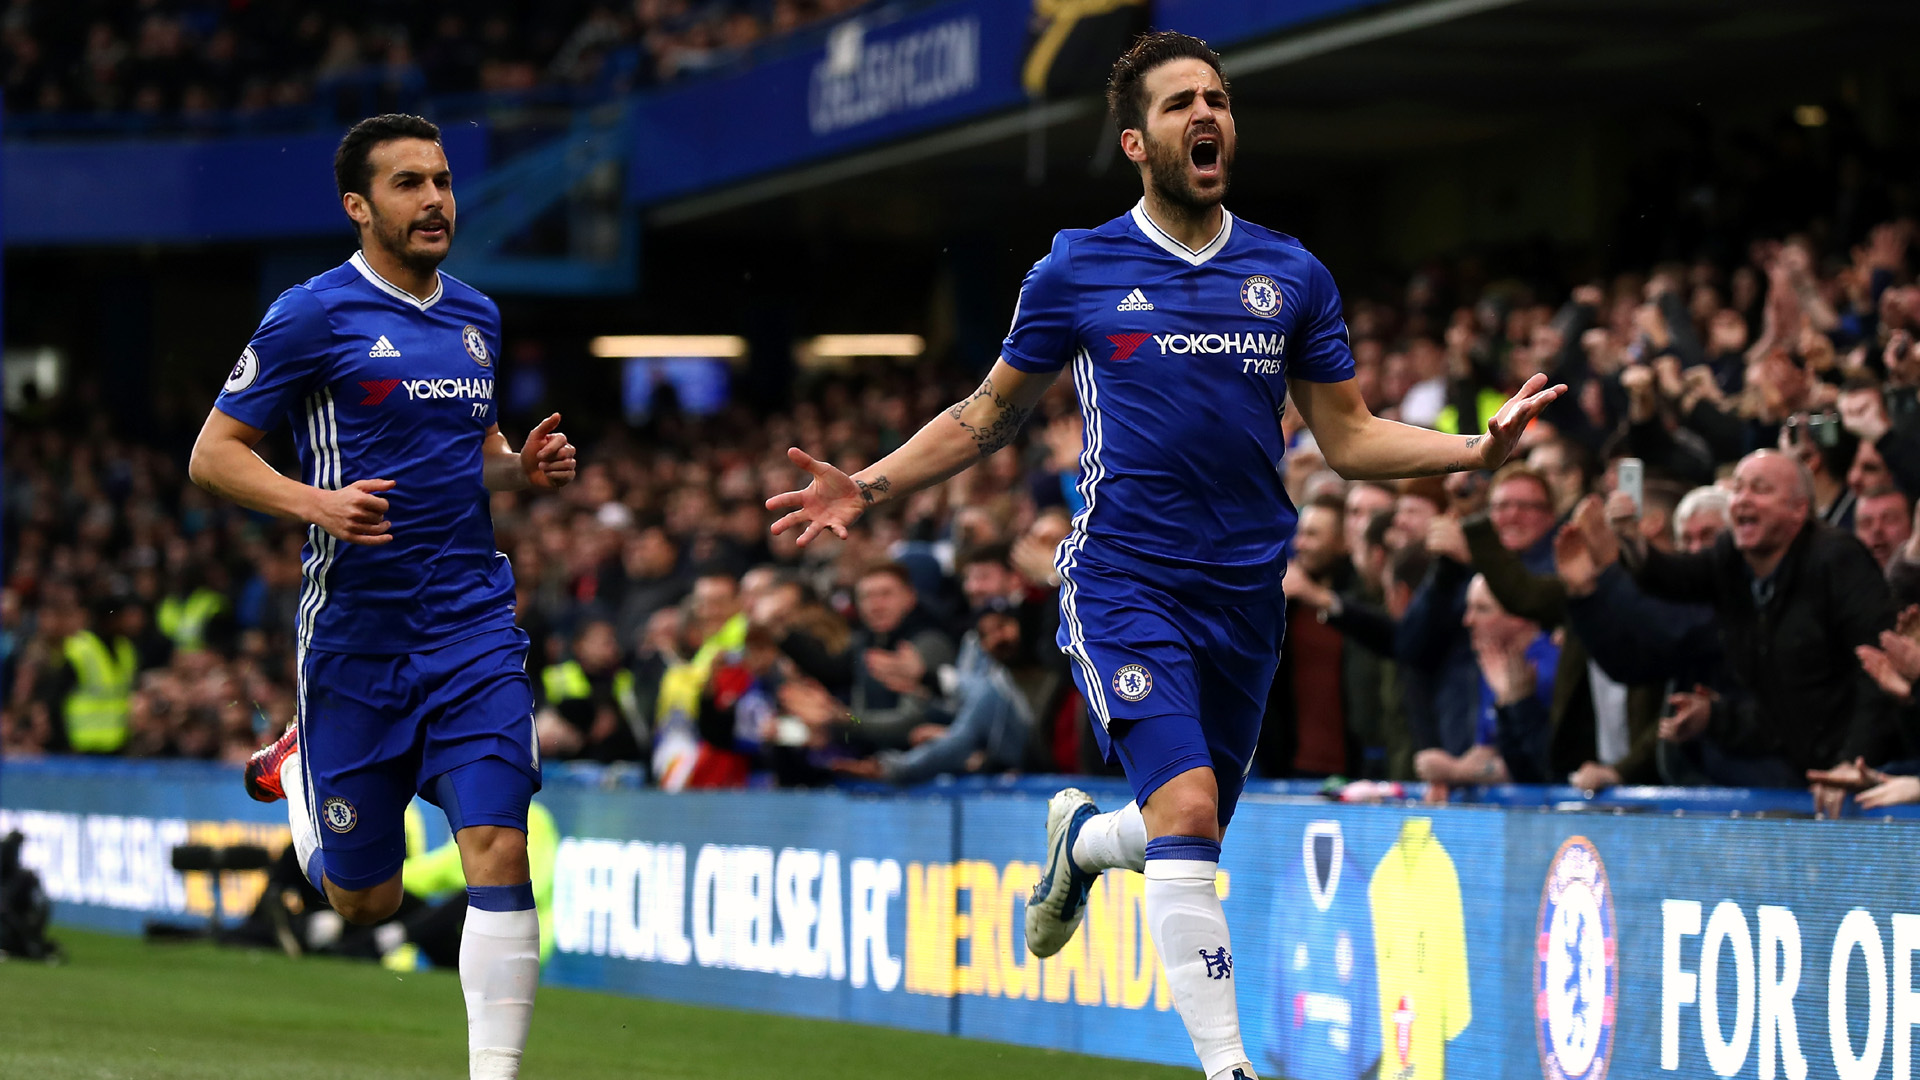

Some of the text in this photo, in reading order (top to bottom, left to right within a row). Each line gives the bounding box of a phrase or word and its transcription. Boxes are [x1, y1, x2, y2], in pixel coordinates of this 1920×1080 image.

[1117, 302, 1154, 311] adidas
[369, 350, 401, 358] adidas
[1153, 333, 1286, 355] YOKOHAMA
[1242, 358, 1281, 374] TYRES
[402, 378, 494, 400] YOKOHAM
[554, 837, 692, 965] OFFICIAL
[692, 843, 845, 980] CHELSEA
[850, 858, 901, 991] FC
[1661, 899, 1807, 1080] FOR
